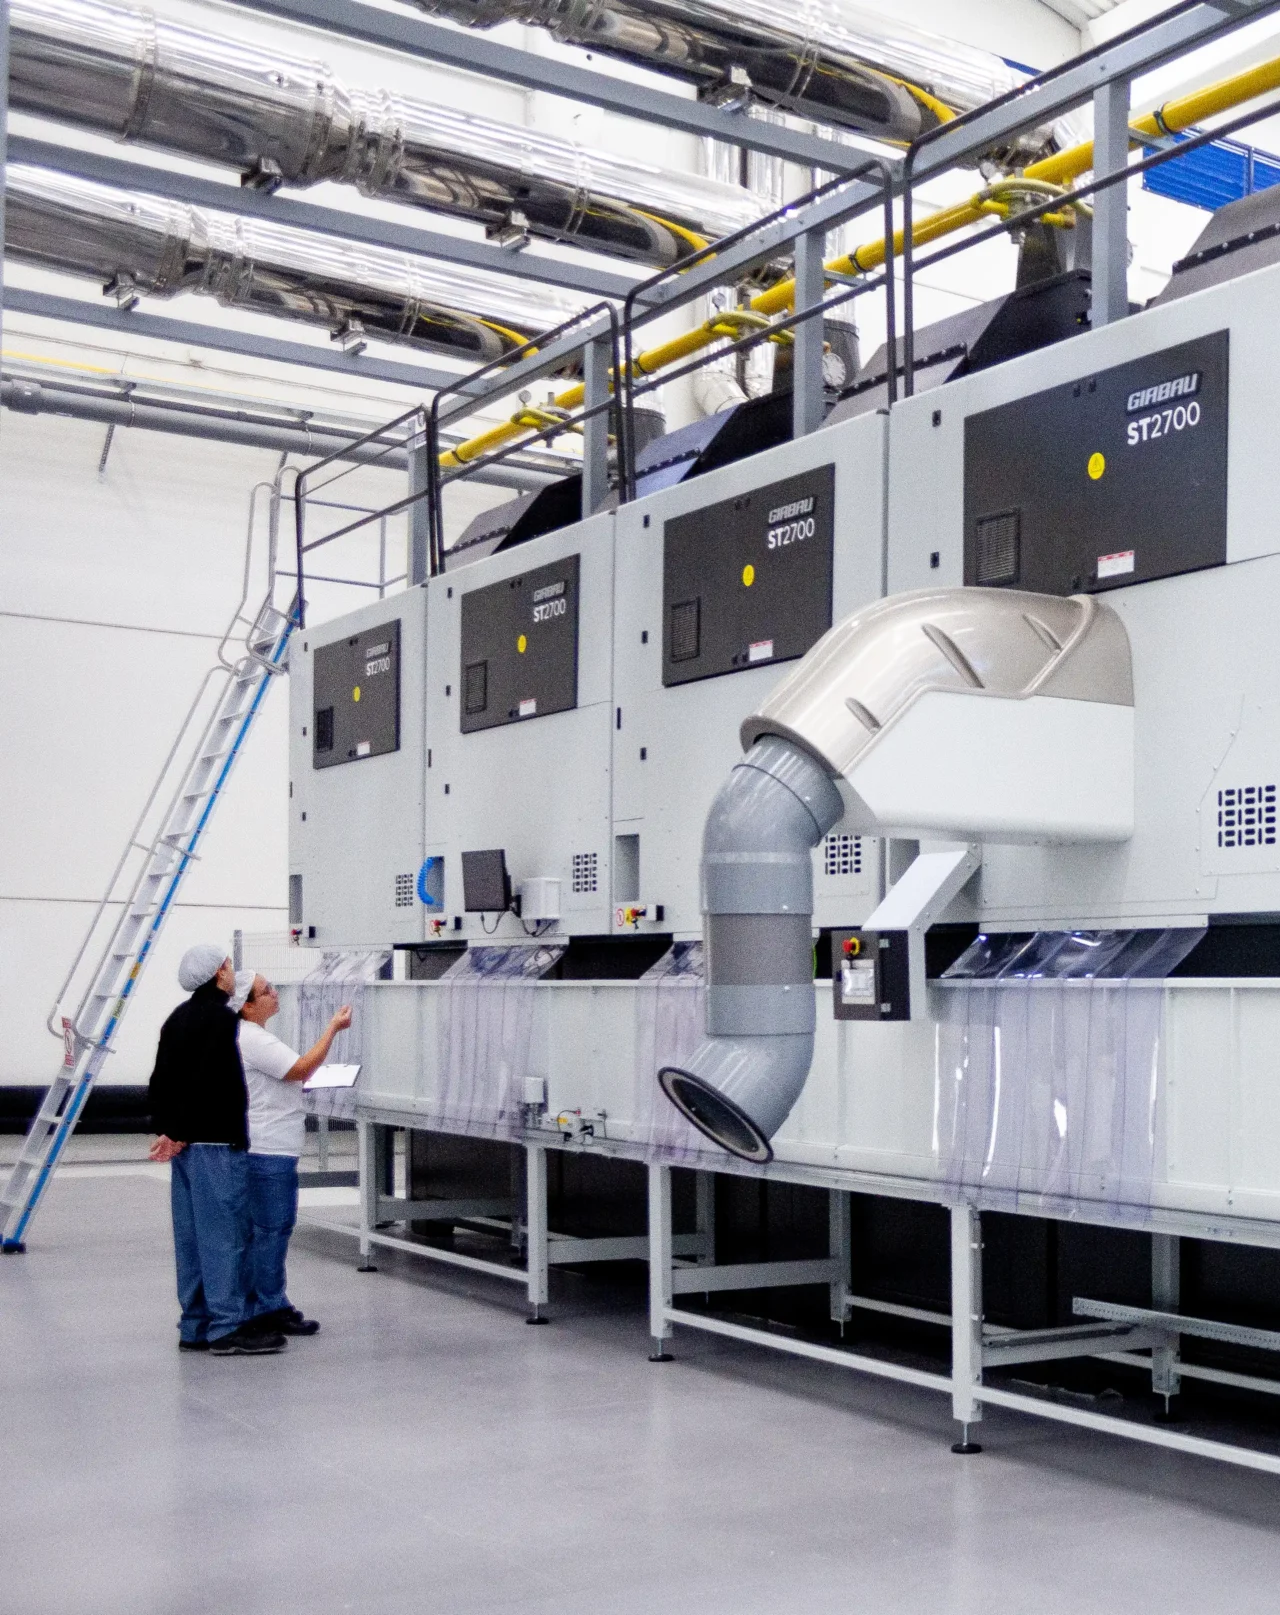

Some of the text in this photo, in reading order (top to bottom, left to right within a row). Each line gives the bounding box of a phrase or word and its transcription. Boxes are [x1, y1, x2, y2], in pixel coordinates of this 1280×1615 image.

[1127, 401, 1200, 446] ST2700
[768, 518, 815, 549] ST2700
[534, 599, 566, 622] ST2700
